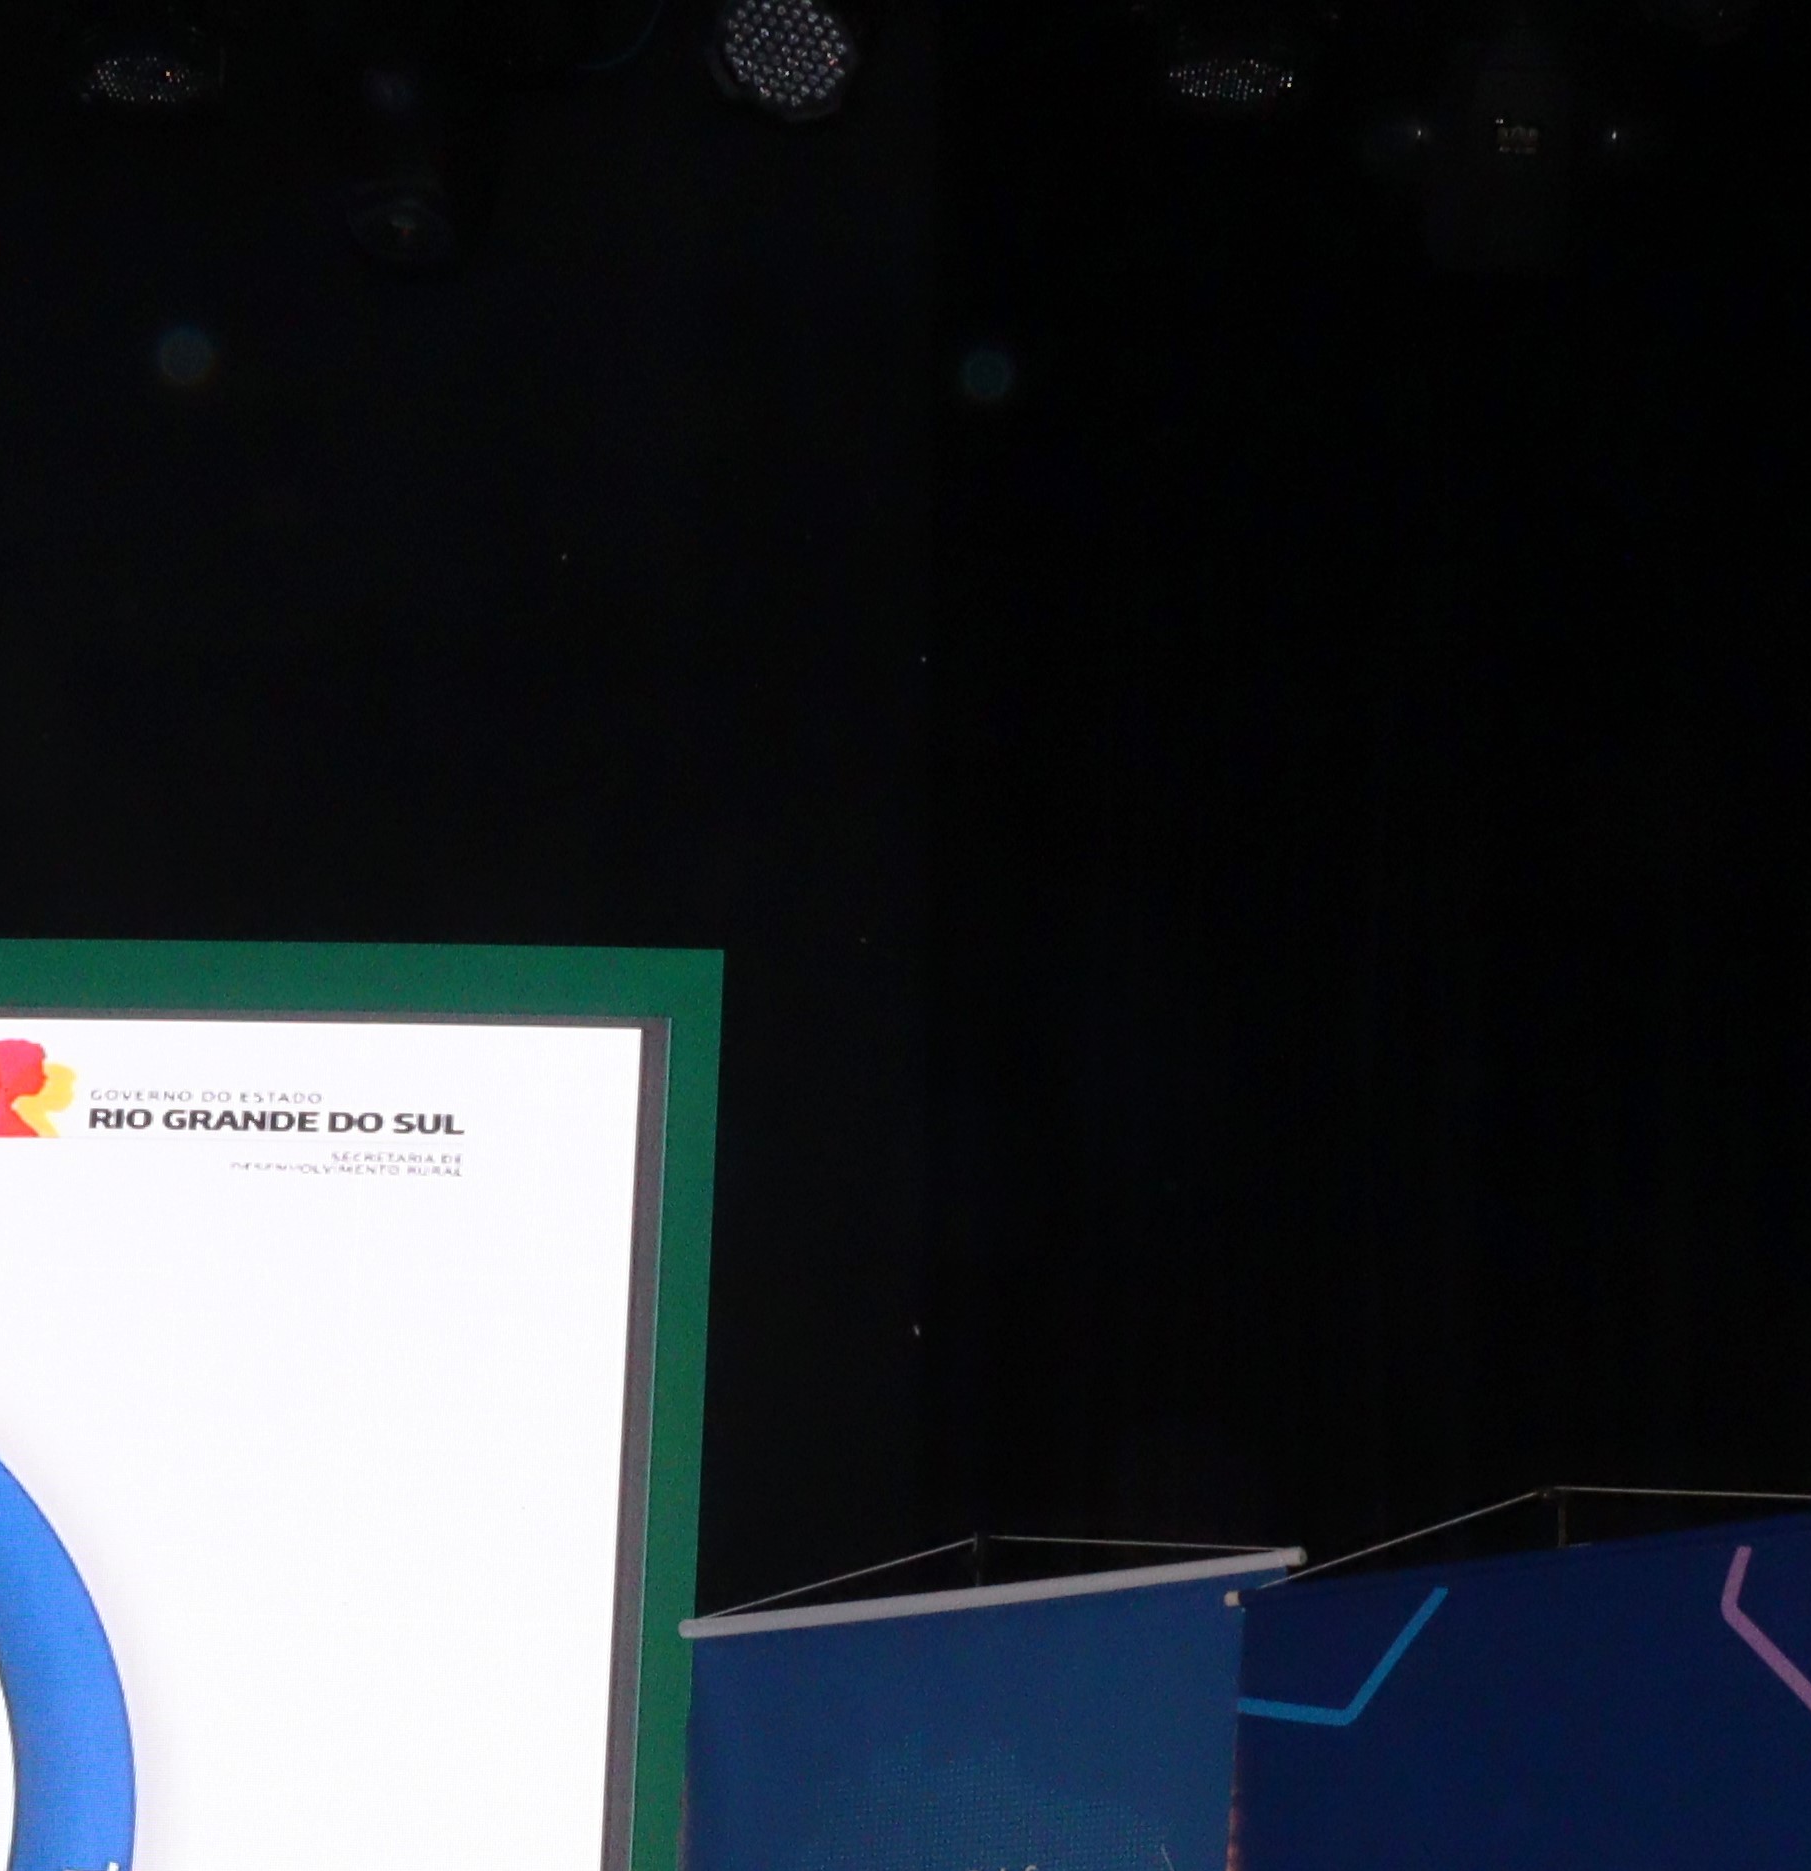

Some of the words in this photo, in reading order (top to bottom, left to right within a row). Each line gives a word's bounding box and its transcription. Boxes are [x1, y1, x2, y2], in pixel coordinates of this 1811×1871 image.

[90, 1090, 192, 1102] GOVERNO
[202, 1091, 231, 1102] DO
[240, 1091, 322, 1103] ESTADO
[89, 1108, 152, 1130] RIO
[162, 1109, 320, 1132] GRANDE
[327, 1112, 383, 1133] DO
[393, 1113, 464, 1135] SUL
